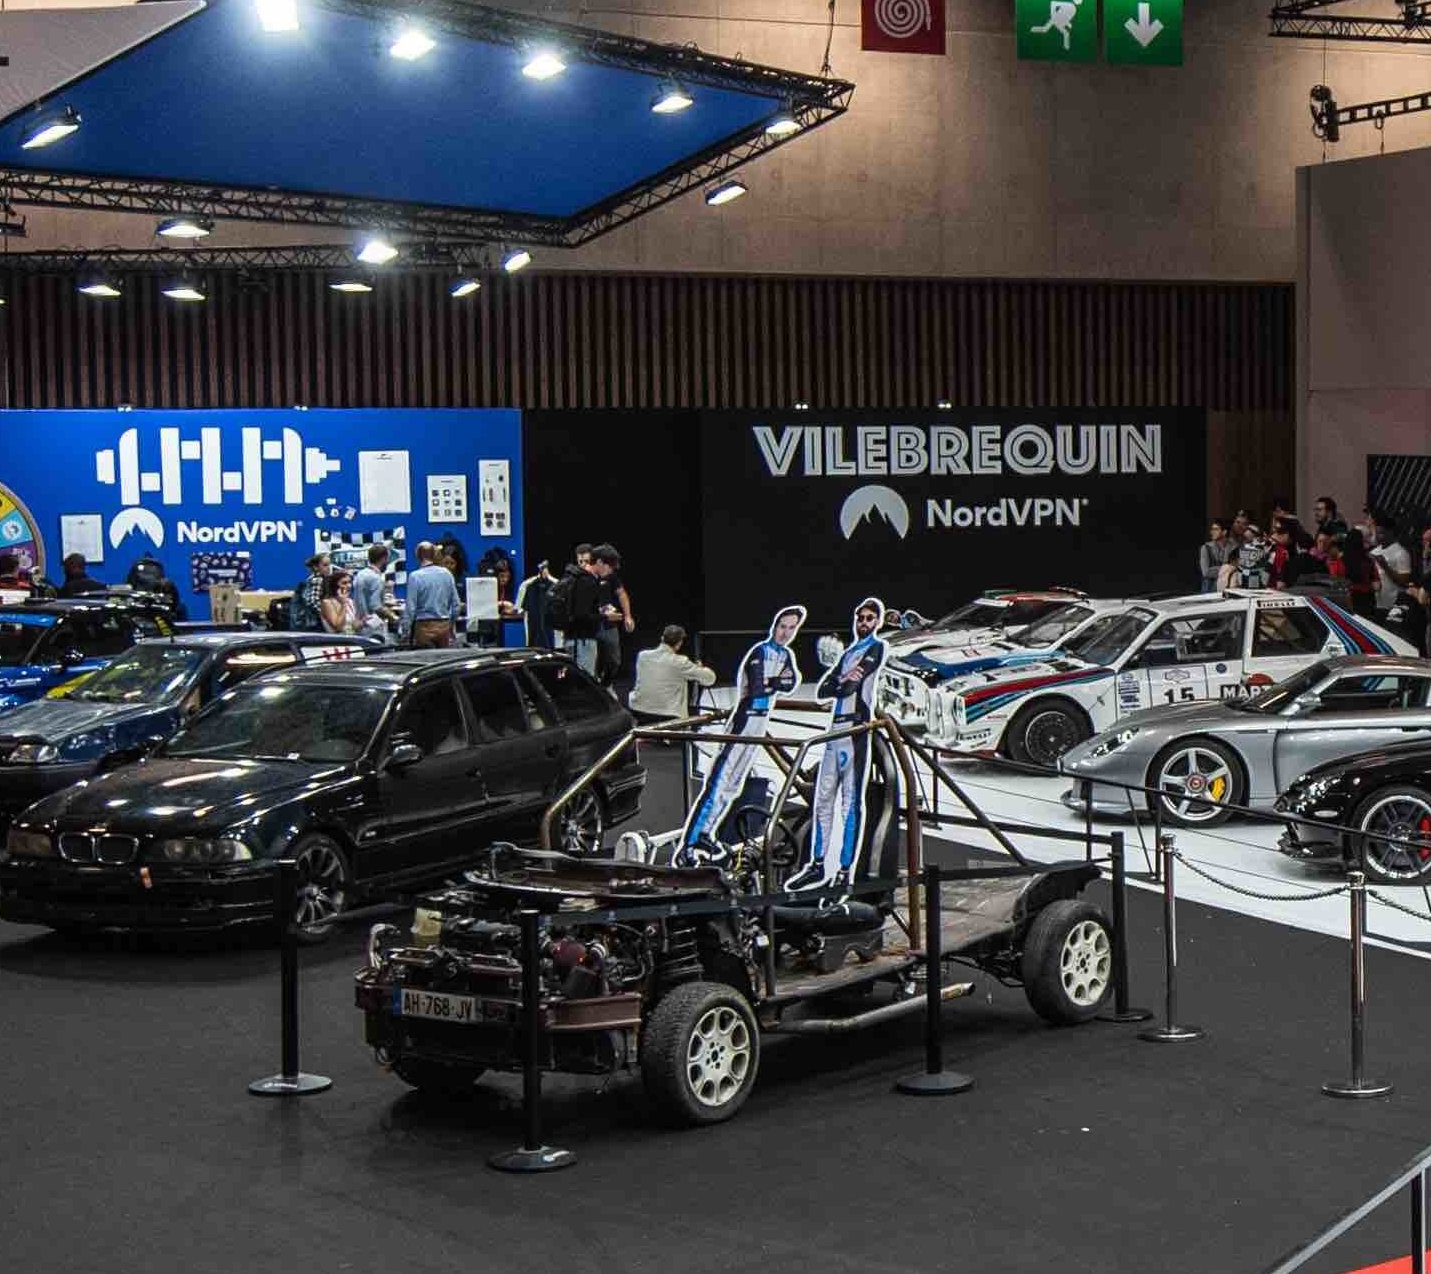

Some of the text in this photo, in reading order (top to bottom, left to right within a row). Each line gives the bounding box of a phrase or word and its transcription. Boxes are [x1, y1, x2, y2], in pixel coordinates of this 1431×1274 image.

[752, 423, 1163, 477] VILEBREQUIN
[926, 497, 1082, 528] NordVPN
[176, 521, 298, 544] NordVPN
